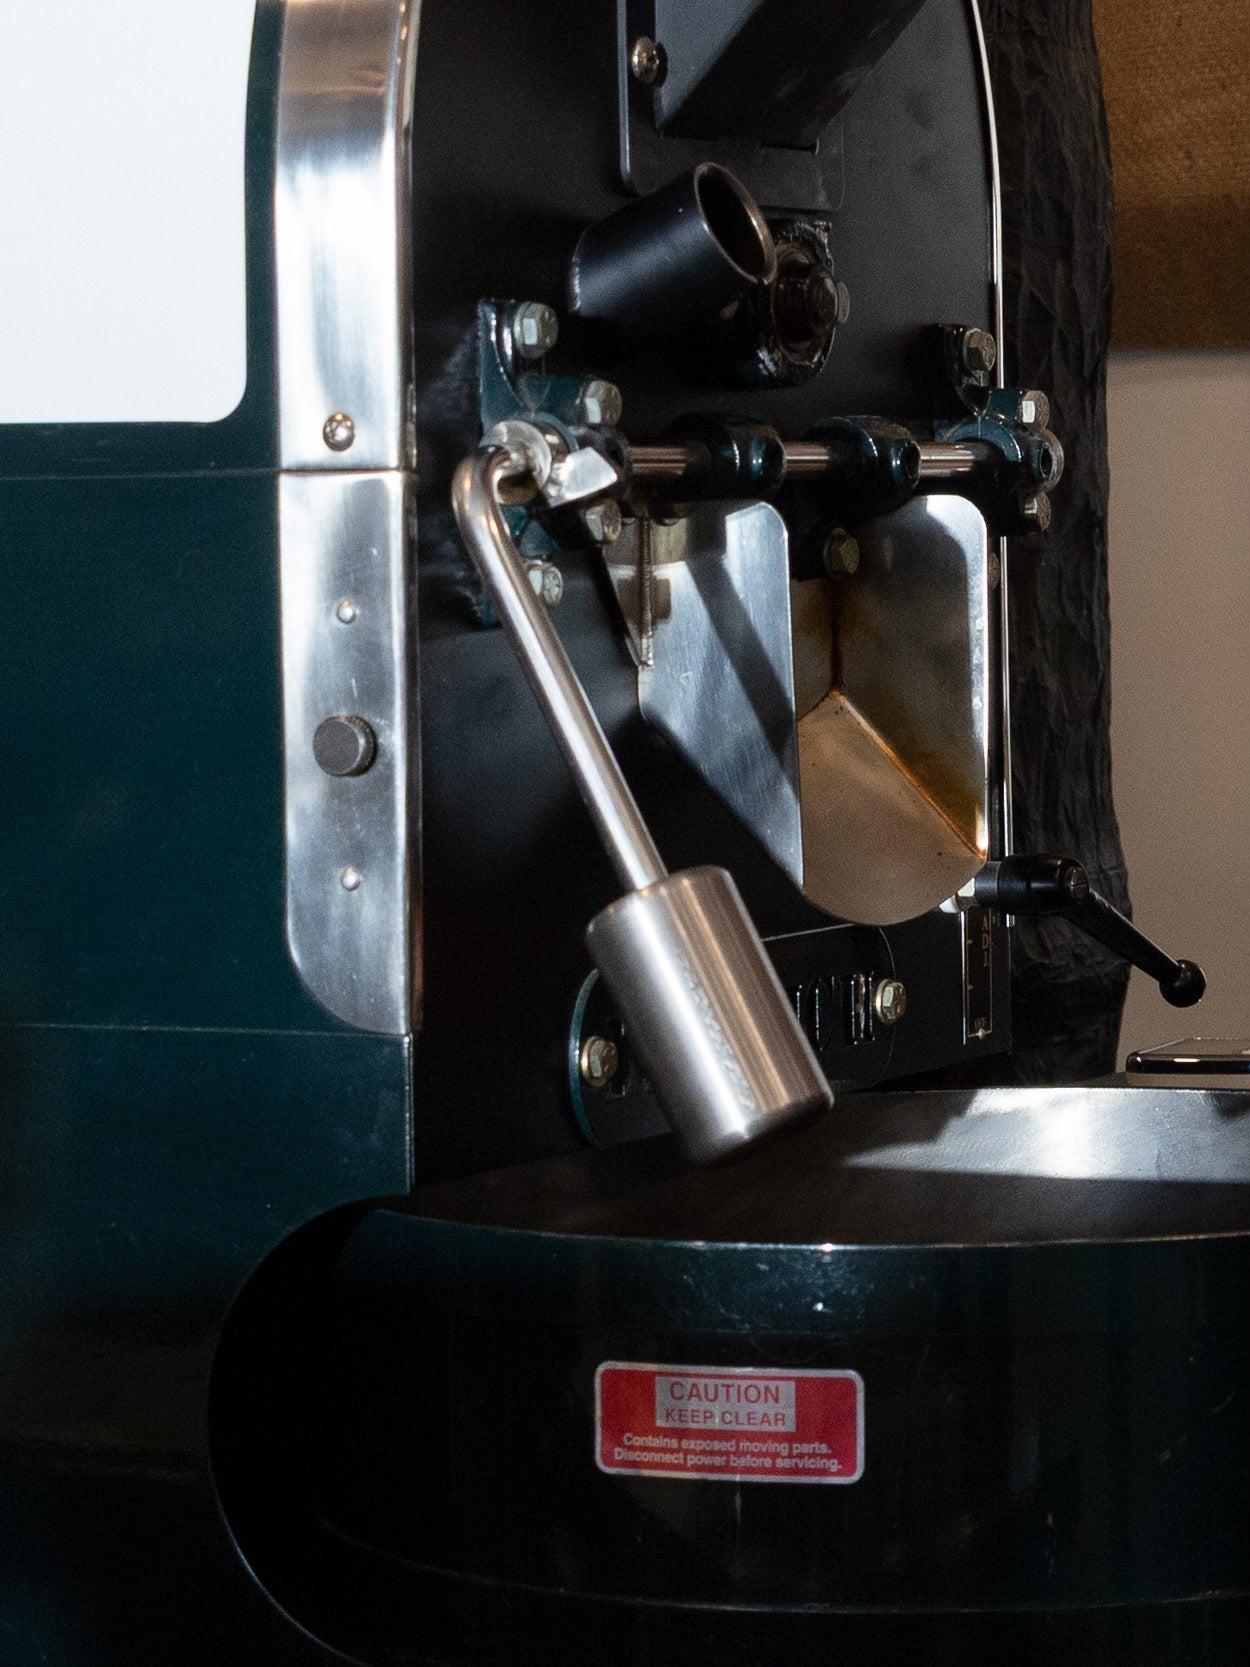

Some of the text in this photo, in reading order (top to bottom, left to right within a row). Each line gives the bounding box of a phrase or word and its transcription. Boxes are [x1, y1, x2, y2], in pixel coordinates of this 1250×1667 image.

[669, 1381, 781, 1404] CAUTION
[664, 1408, 787, 1427] KEEP CLEAR
[623, 1432, 832, 1456] Contains exposed moving parts.
[614, 1446, 842, 1472] Disconnect power before servicing.
